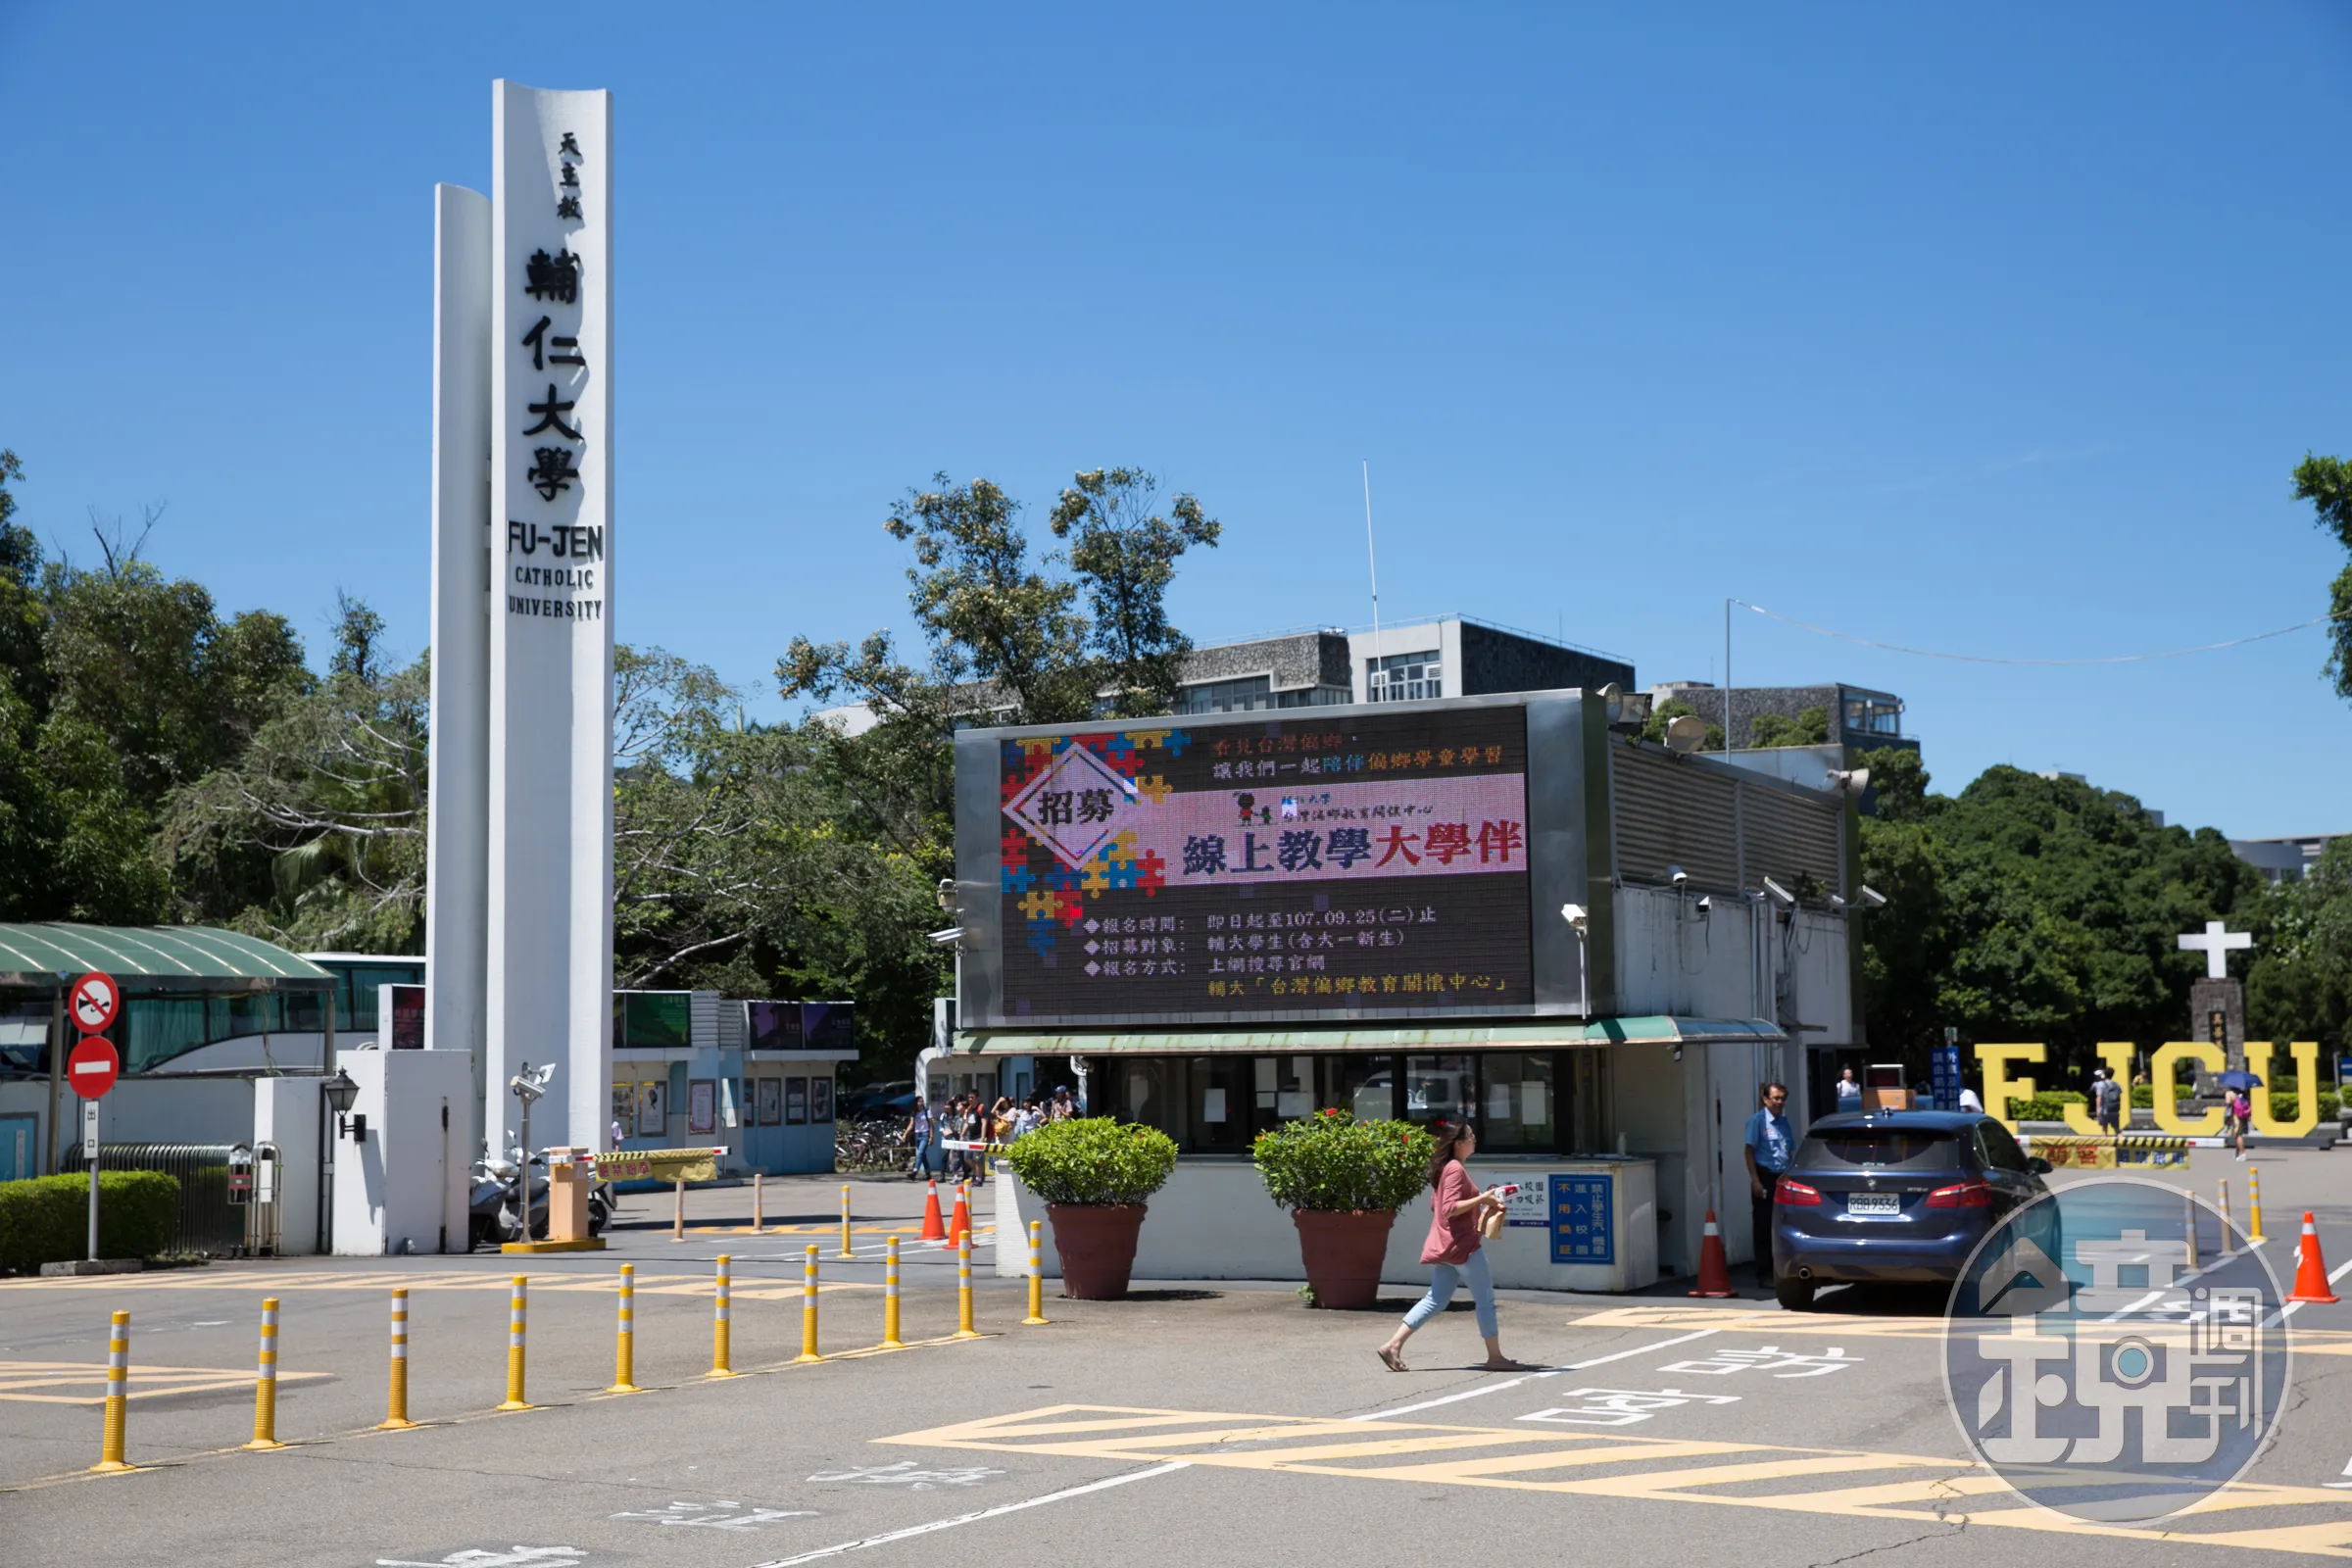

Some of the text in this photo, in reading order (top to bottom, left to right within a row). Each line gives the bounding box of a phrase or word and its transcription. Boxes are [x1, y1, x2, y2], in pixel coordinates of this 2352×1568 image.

[557, 131, 583, 220] 天主教
[522, 249, 586, 502] 輔仁大學
[507, 519, 603, 561] FU-JEN
[514, 565, 594, 589] CATHOLIC
[509, 595, 602, 620] UNIVERSITY
[1037, 788, 1114, 825] 招募
[1182, 819, 1524, 877] 線上教學大學伴
[1207, 955, 1326, 974] 上網搜尋官網
[1974, 1041, 2320, 1139] FJCU
[86, 1108, 96, 1150] 出口
[1514, 1345, 1867, 1427] 訪客
